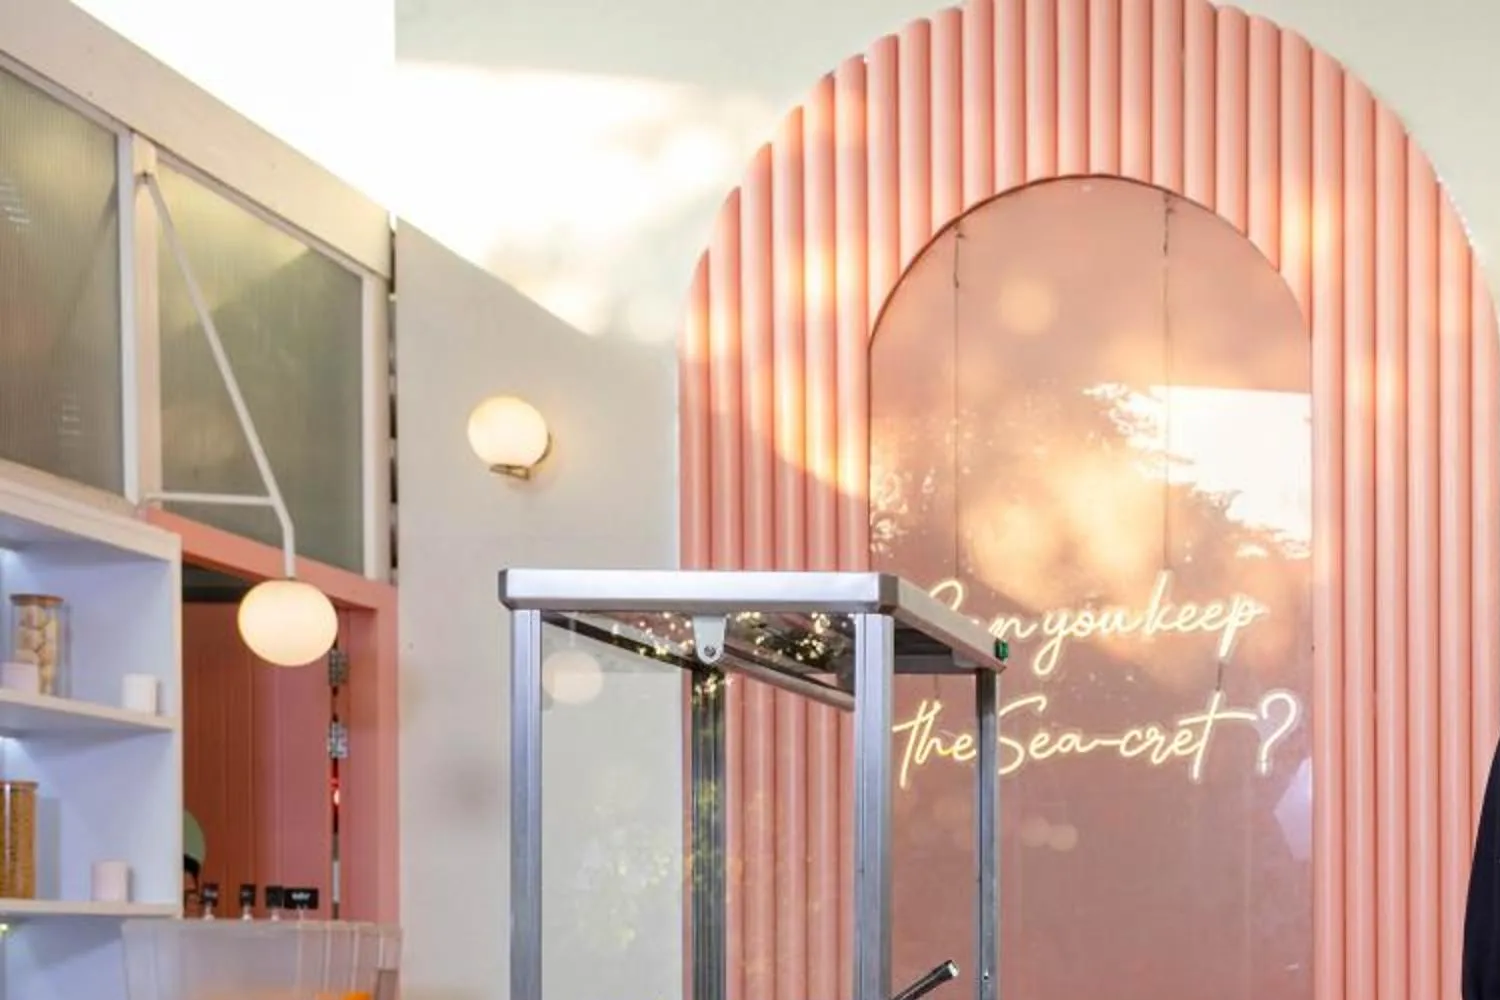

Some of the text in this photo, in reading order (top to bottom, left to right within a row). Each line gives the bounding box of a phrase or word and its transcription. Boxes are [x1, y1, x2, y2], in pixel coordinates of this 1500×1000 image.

[1033, 604, 1137, 676] you
[1138, 569, 1270, 658] keep
[893, 699, 977, 789] the
